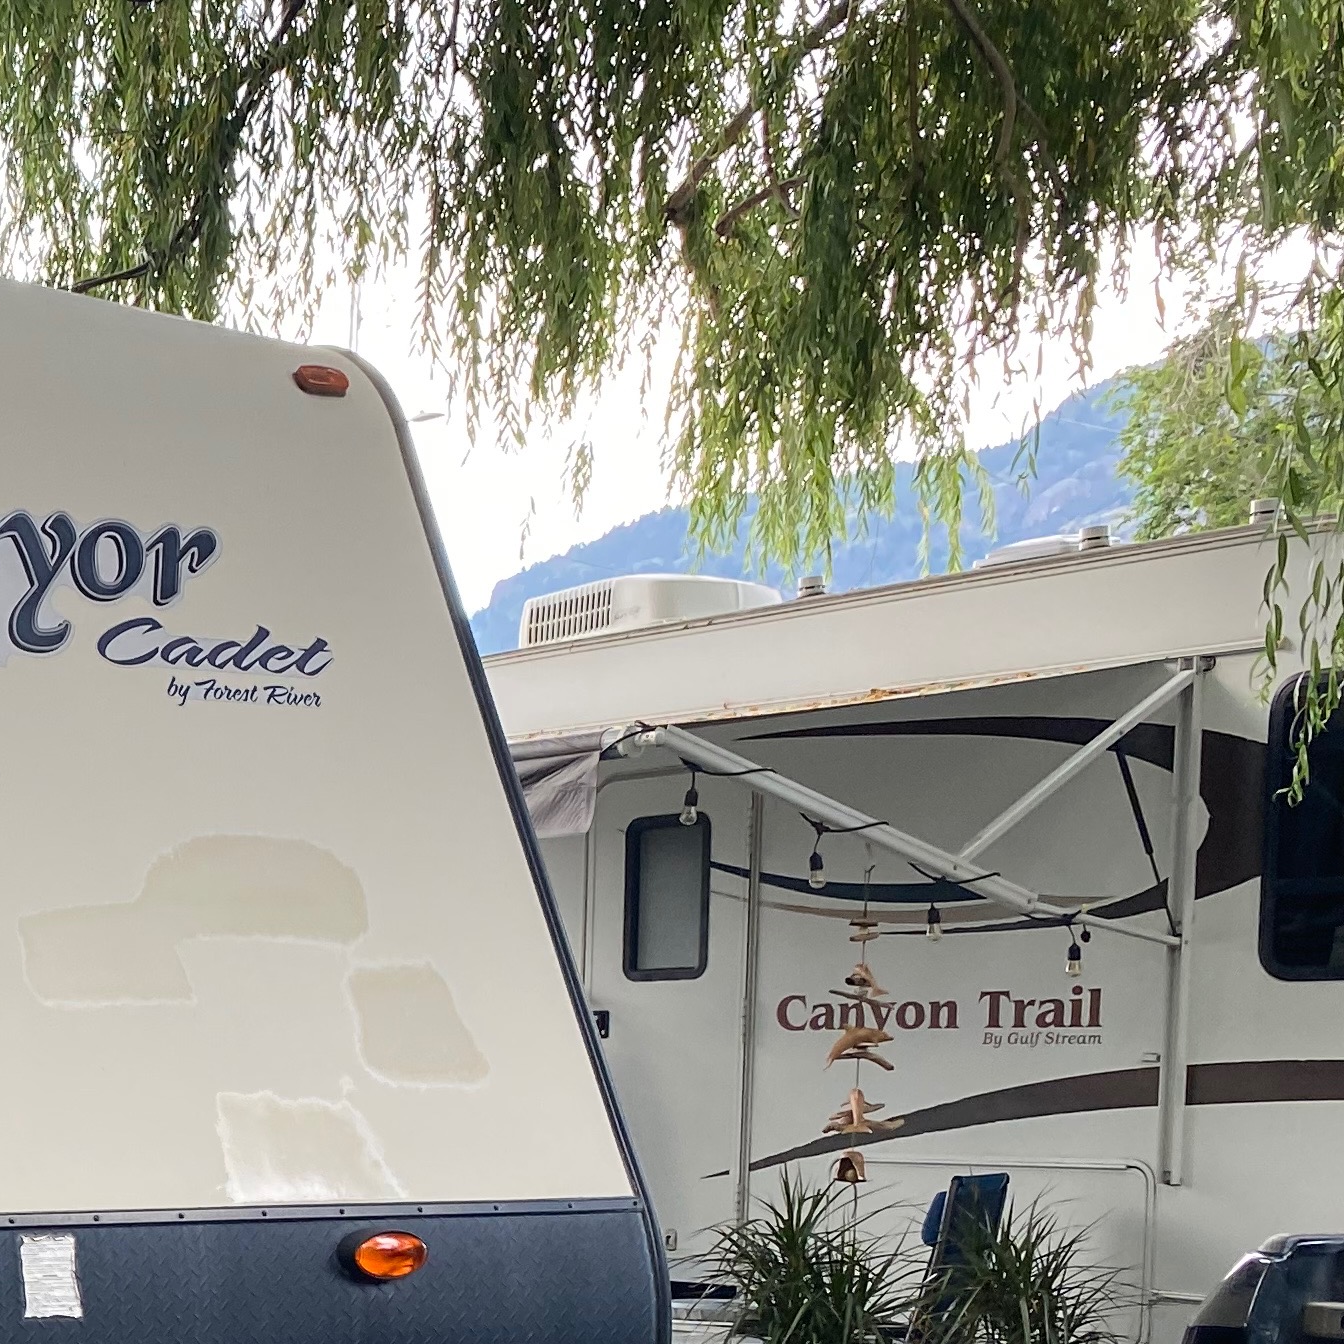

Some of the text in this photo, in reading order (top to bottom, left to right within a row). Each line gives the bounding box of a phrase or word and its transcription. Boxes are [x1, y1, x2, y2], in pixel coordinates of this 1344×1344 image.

[97, 617, 333, 676] Cadet
[167, 676, 322, 708] by Forest River
[776, 985, 1103, 1032] Canyon Trail
[982, 1031, 1102, 1048] By Gulf Stream
